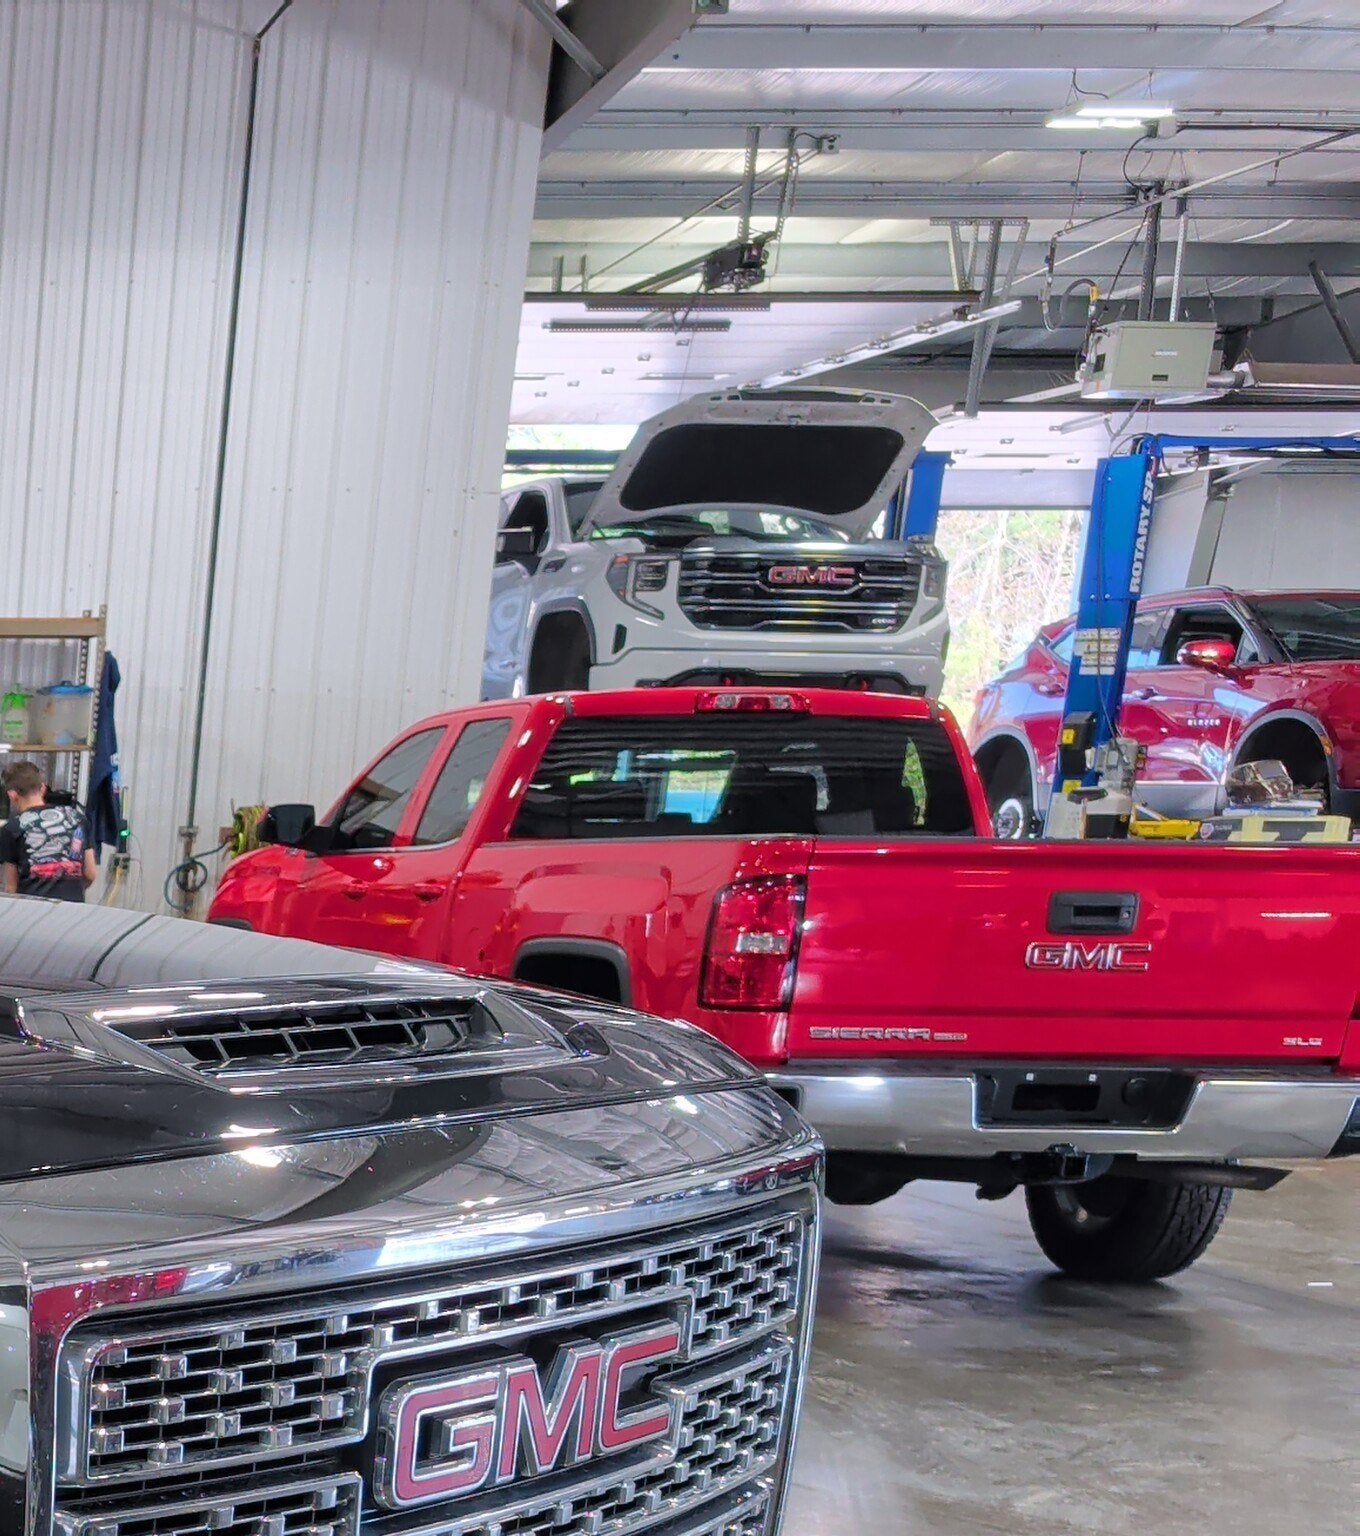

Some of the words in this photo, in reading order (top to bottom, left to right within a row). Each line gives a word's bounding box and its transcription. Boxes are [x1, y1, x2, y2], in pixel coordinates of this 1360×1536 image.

[1129, 504, 1151, 593] ROTARY
[767, 565, 856, 586] GMC
[1025, 941, 1153, 970] GMC
[809, 1026, 931, 1041] SIERRA
[378, 1319, 680, 1509] GMC
